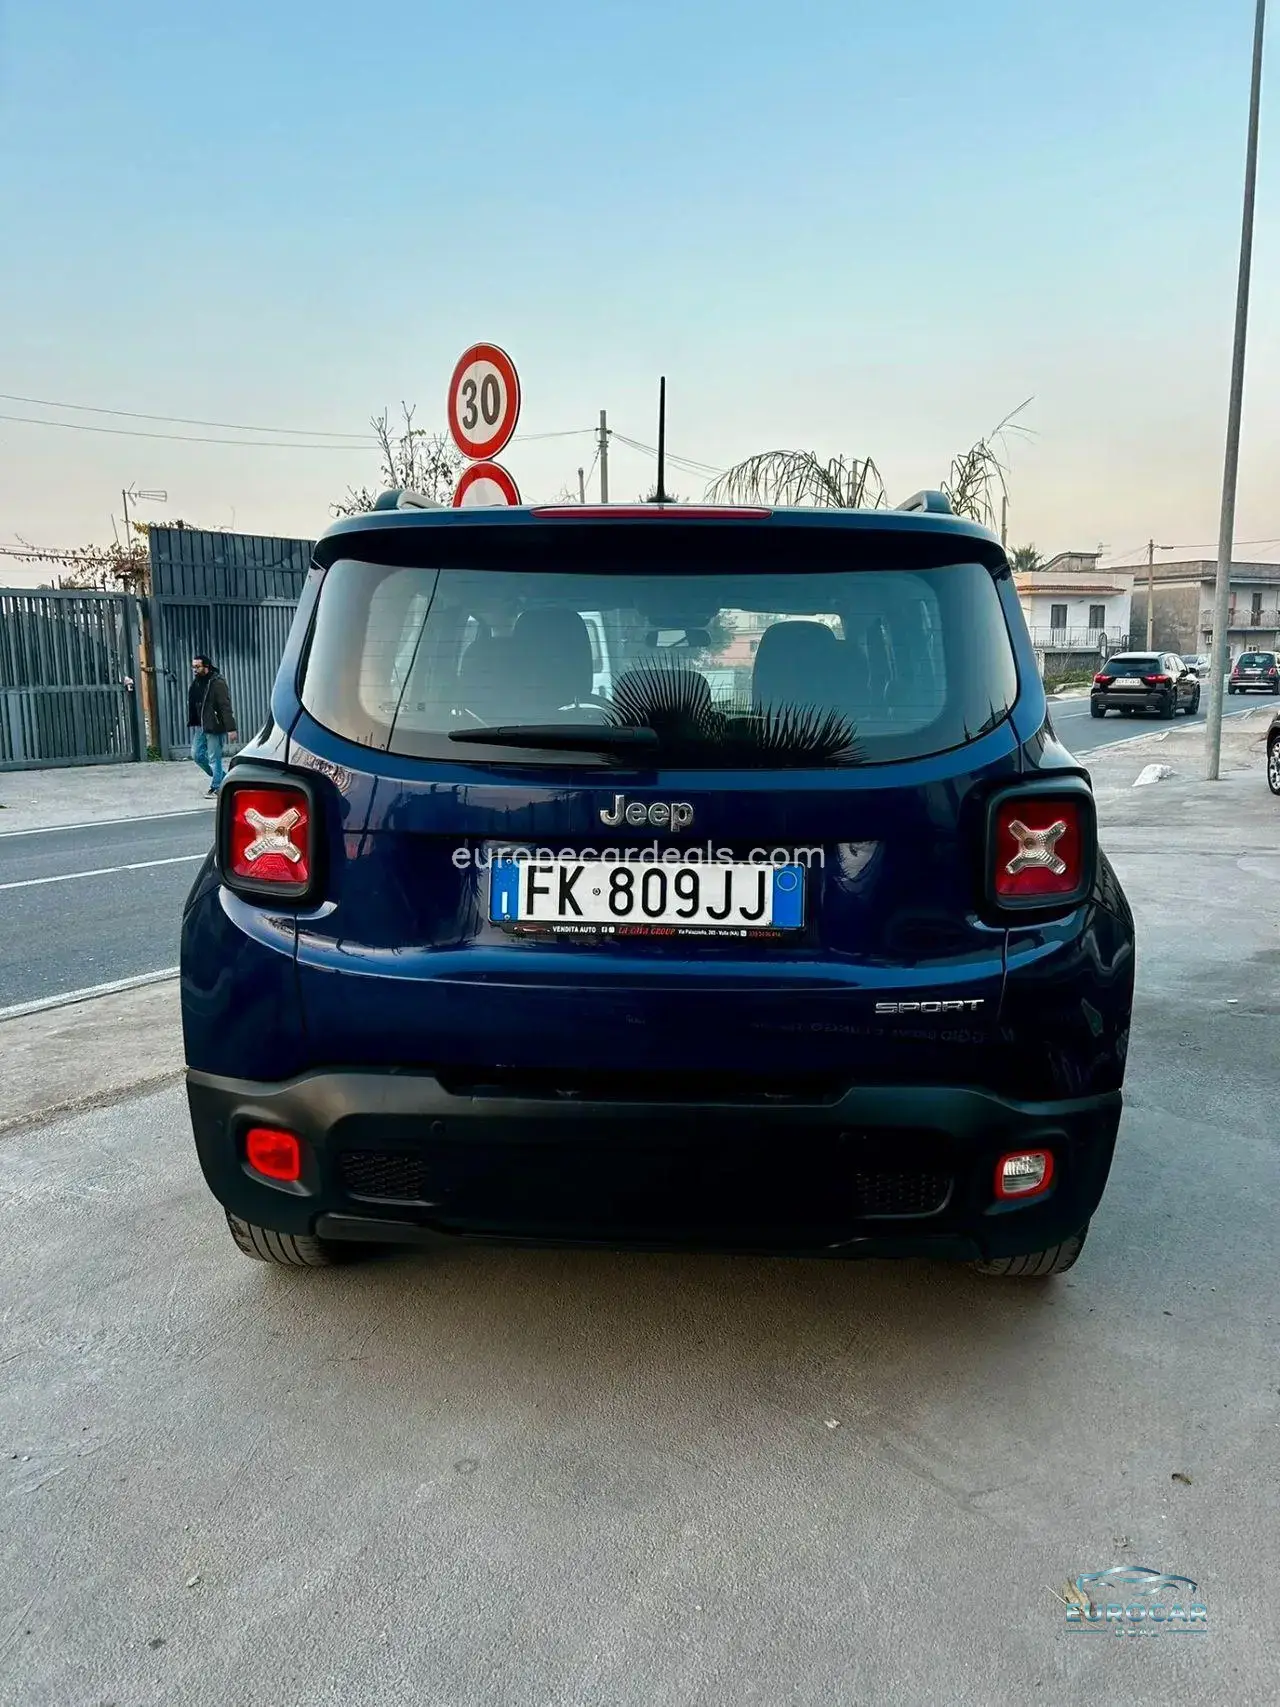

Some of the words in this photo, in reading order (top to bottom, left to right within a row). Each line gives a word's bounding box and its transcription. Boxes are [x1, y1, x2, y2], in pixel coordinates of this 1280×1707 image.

[462, 373, 500, 430] 30
[600, 794, 694, 832] Jeep
[526, 864, 585, 916] FK
[608, 866, 766, 920] 809JJ
[552, 925, 578, 933] VENDITA
[650, 927, 676, 935] GROUP
[874, 999, 985, 1014] SPORT
